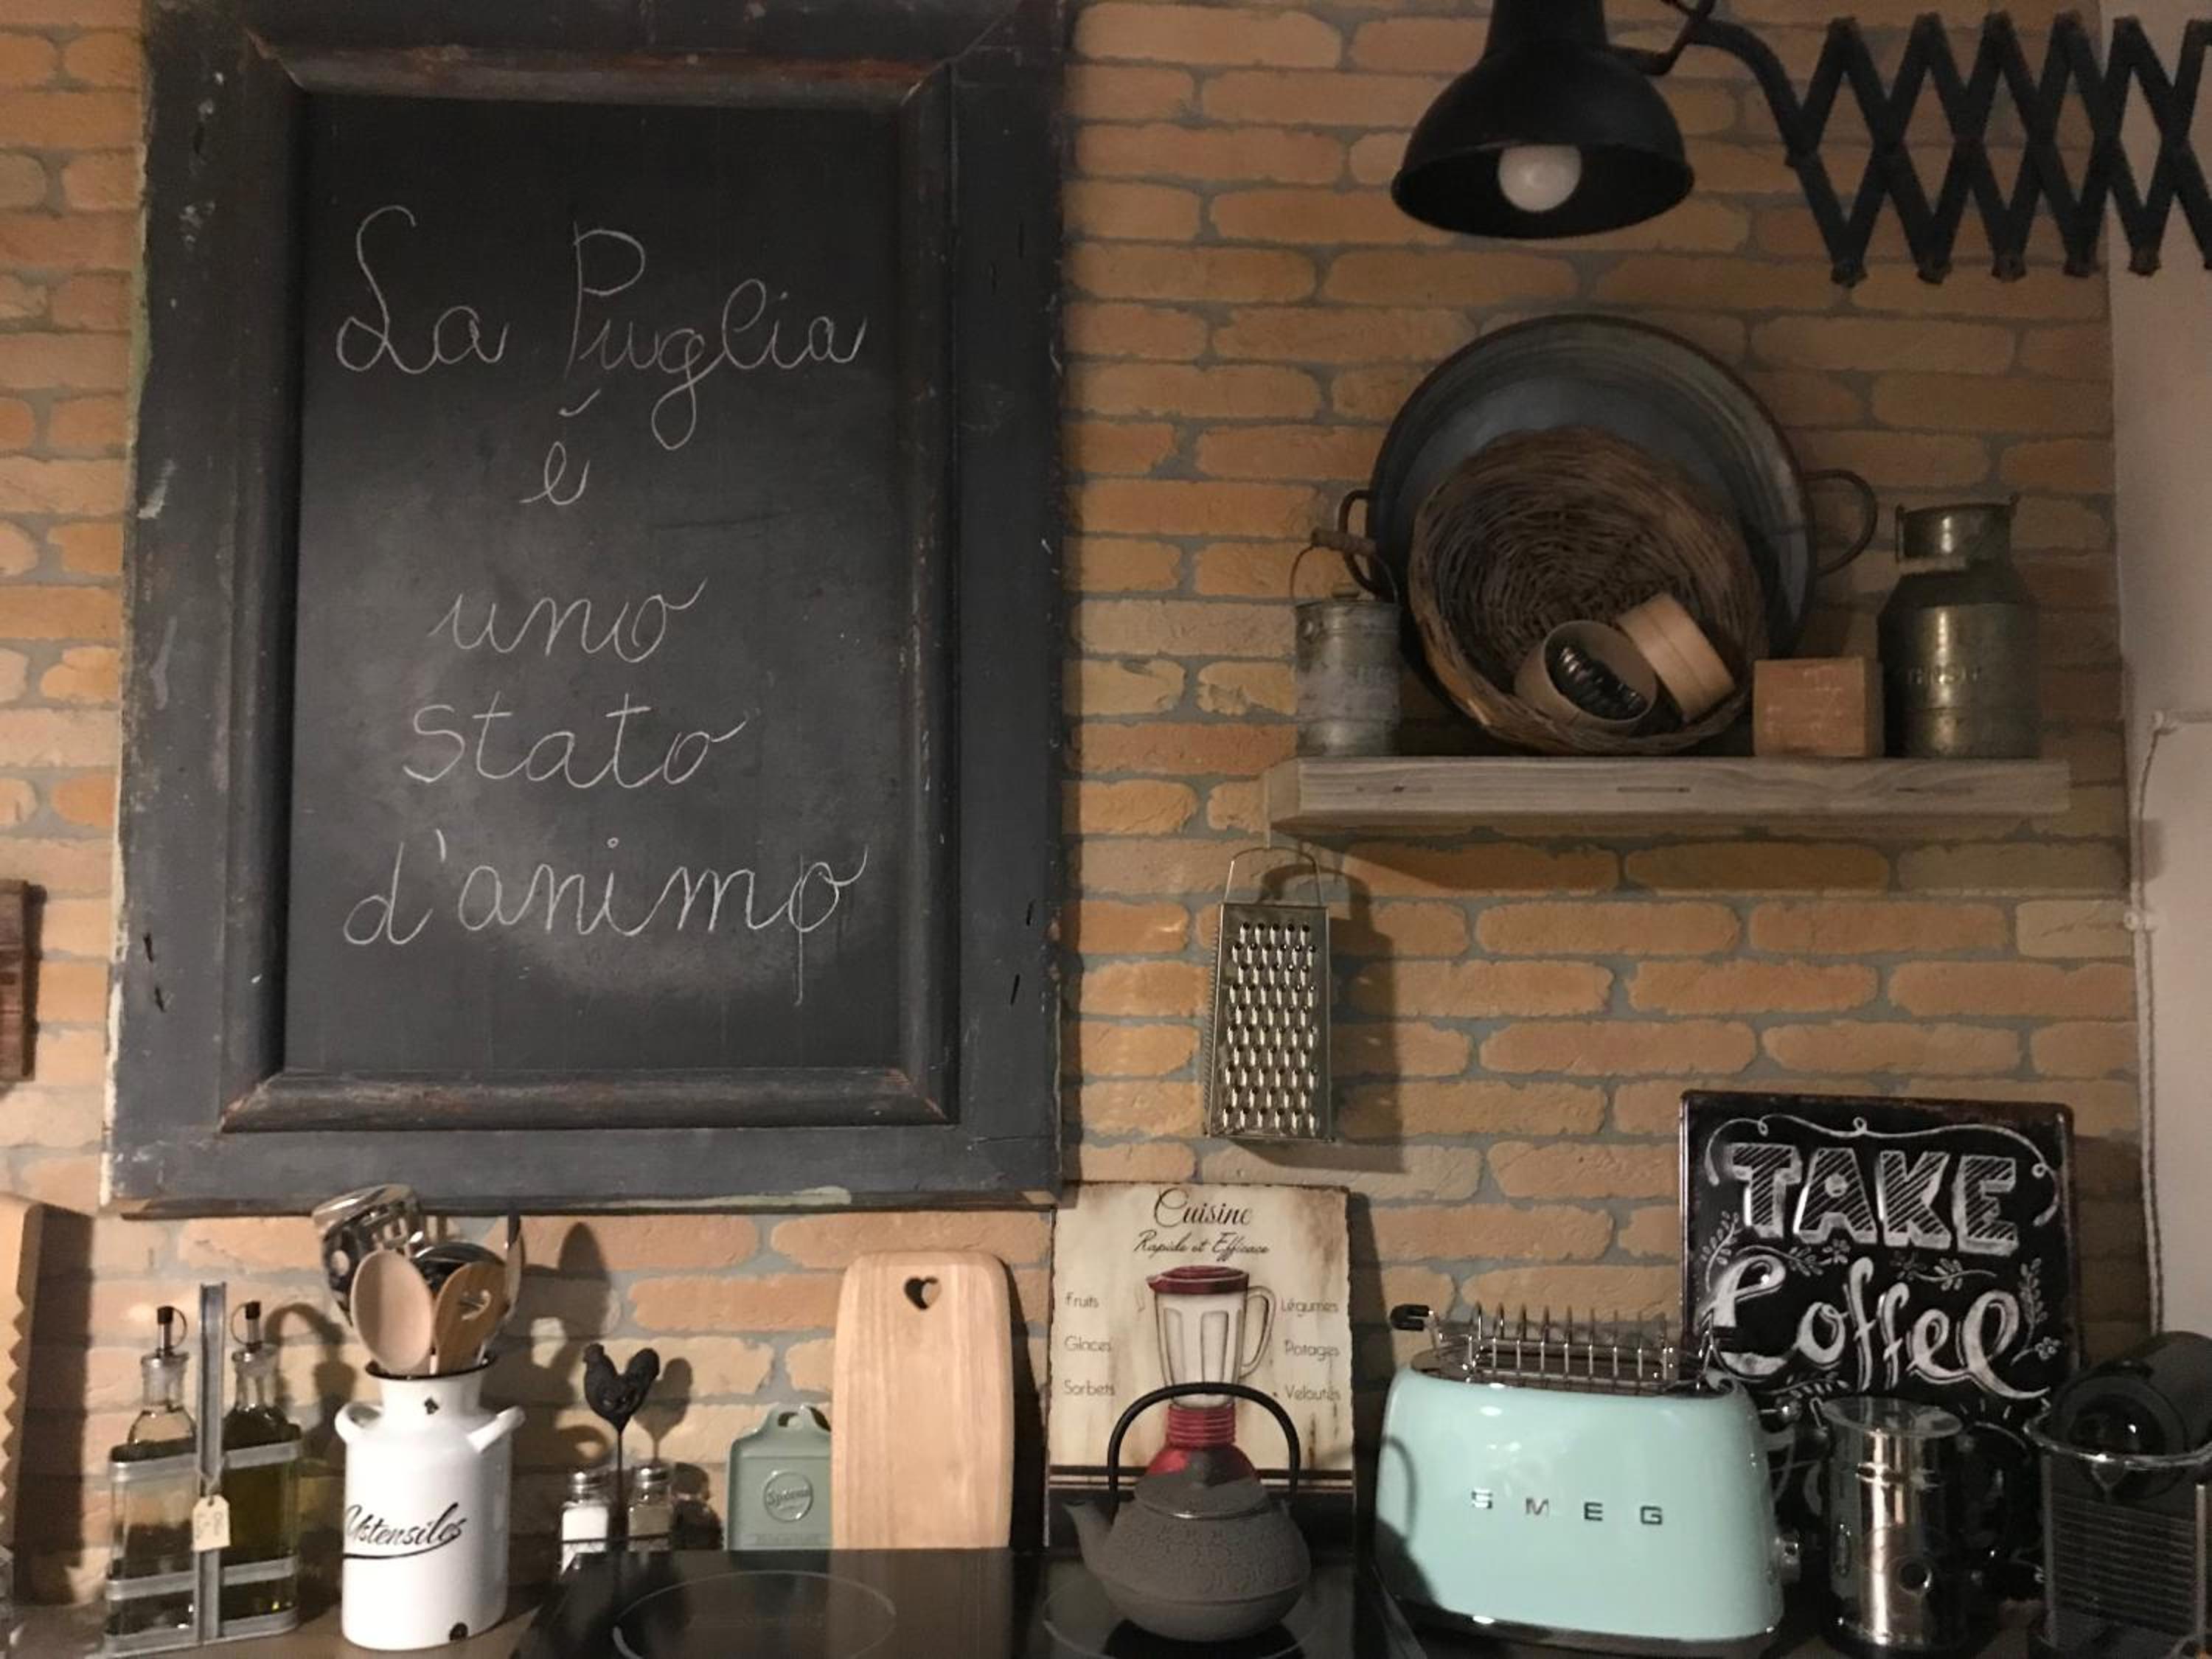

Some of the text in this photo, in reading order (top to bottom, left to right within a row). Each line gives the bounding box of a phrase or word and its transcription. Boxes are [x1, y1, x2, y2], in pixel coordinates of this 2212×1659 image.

[335, 206, 867, 449] La Puglia
[428, 577, 708, 662] uno
[343, 828, 869, 945] d'animo
[1154, 1187, 1253, 1228] Cuisine
[1724, 1141, 2020, 1257] TAKE
[1065, 1291, 1099, 1309] Fruits
[1064, 1335, 1112, 1352] Glaces
[1285, 1338, 1340, 1362] Potages
[1064, 1380, 1116, 1397] Sorbets
[344, 1502, 467, 1545] Ustensiles
[1470, 1487, 1663, 1526] SMEG
